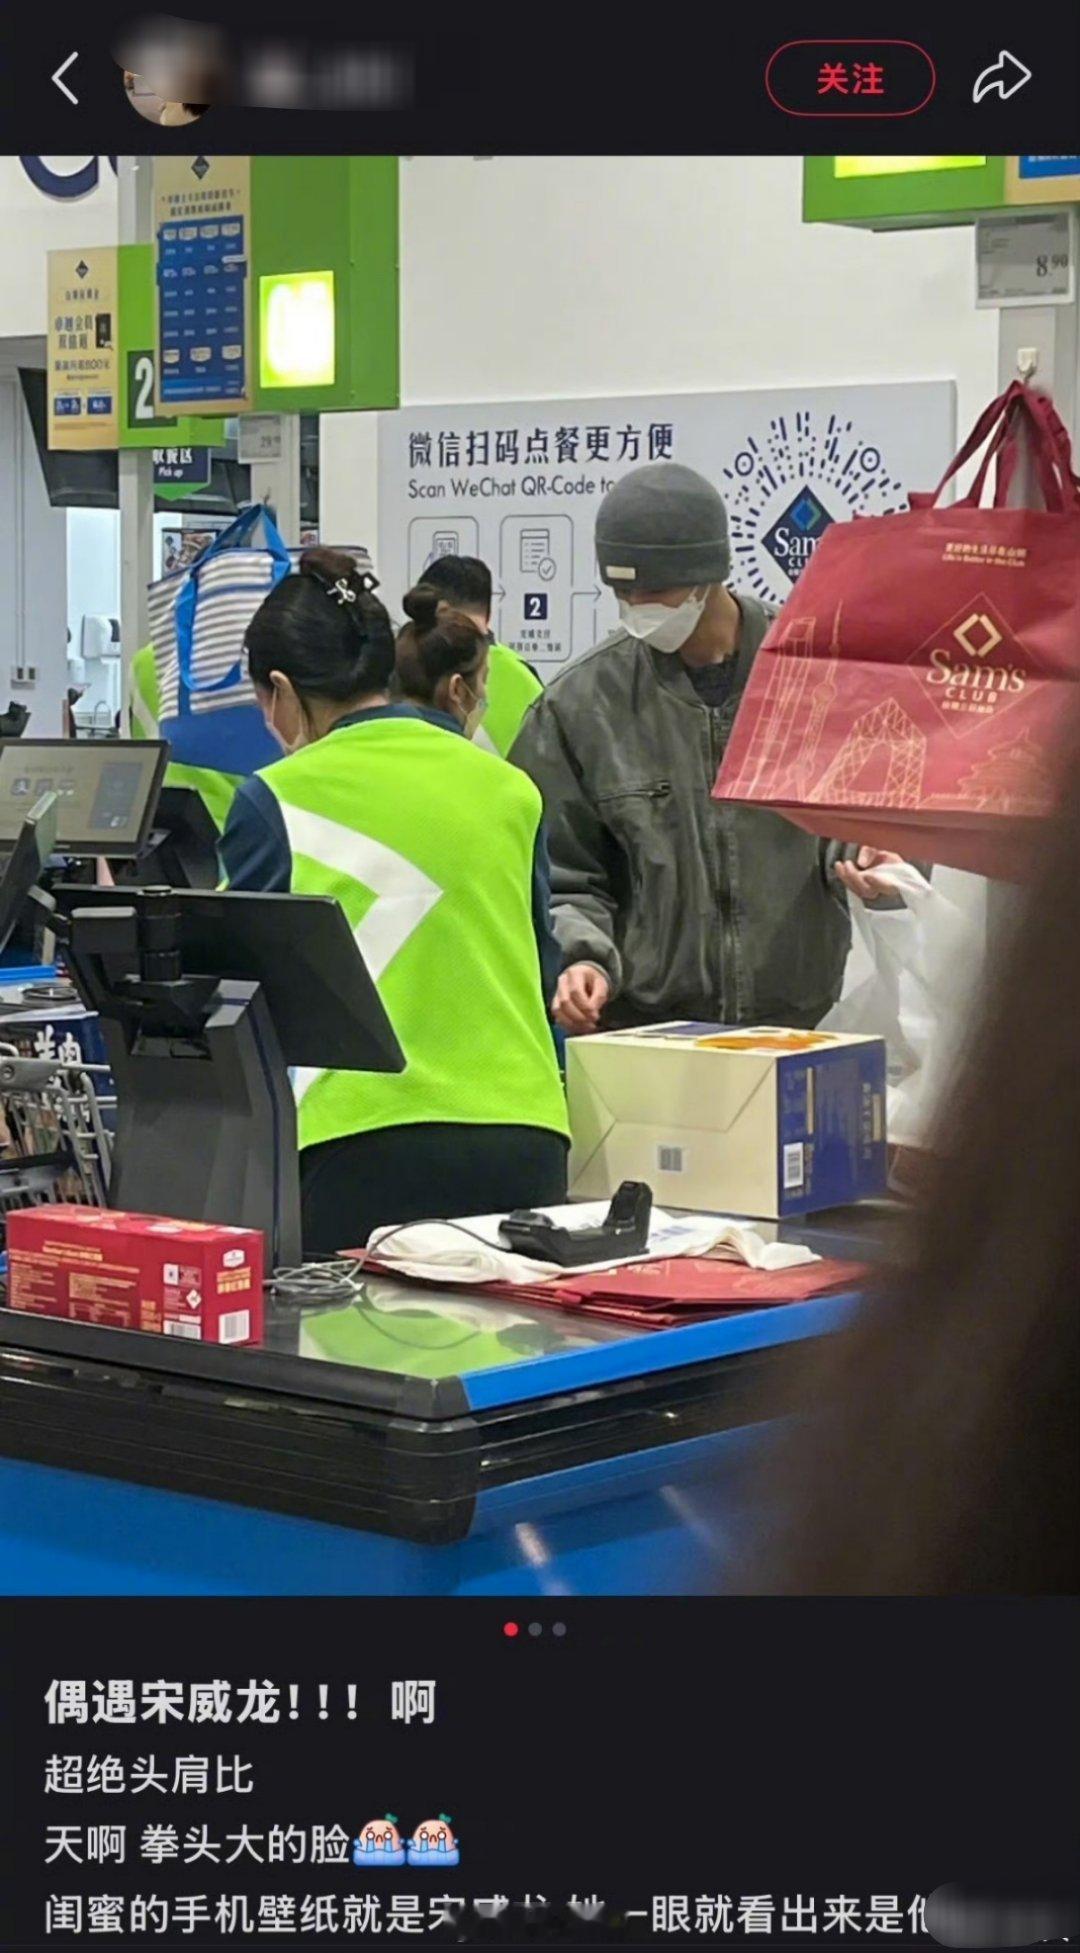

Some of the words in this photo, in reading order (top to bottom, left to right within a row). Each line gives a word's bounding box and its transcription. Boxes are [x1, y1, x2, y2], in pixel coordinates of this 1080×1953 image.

[135, 357, 153, 419] 2
[408, 423, 674, 469] 微信扫码点餐更方便
[408, 478, 446, 499] Scan
[451, 476, 516, 498] WeChat
[521, 474, 595, 497] QR-Code
[529, 597, 541, 617] 2
[926, 648, 1027, 693] Sam's
[945, 686, 998, 704] CLUB
